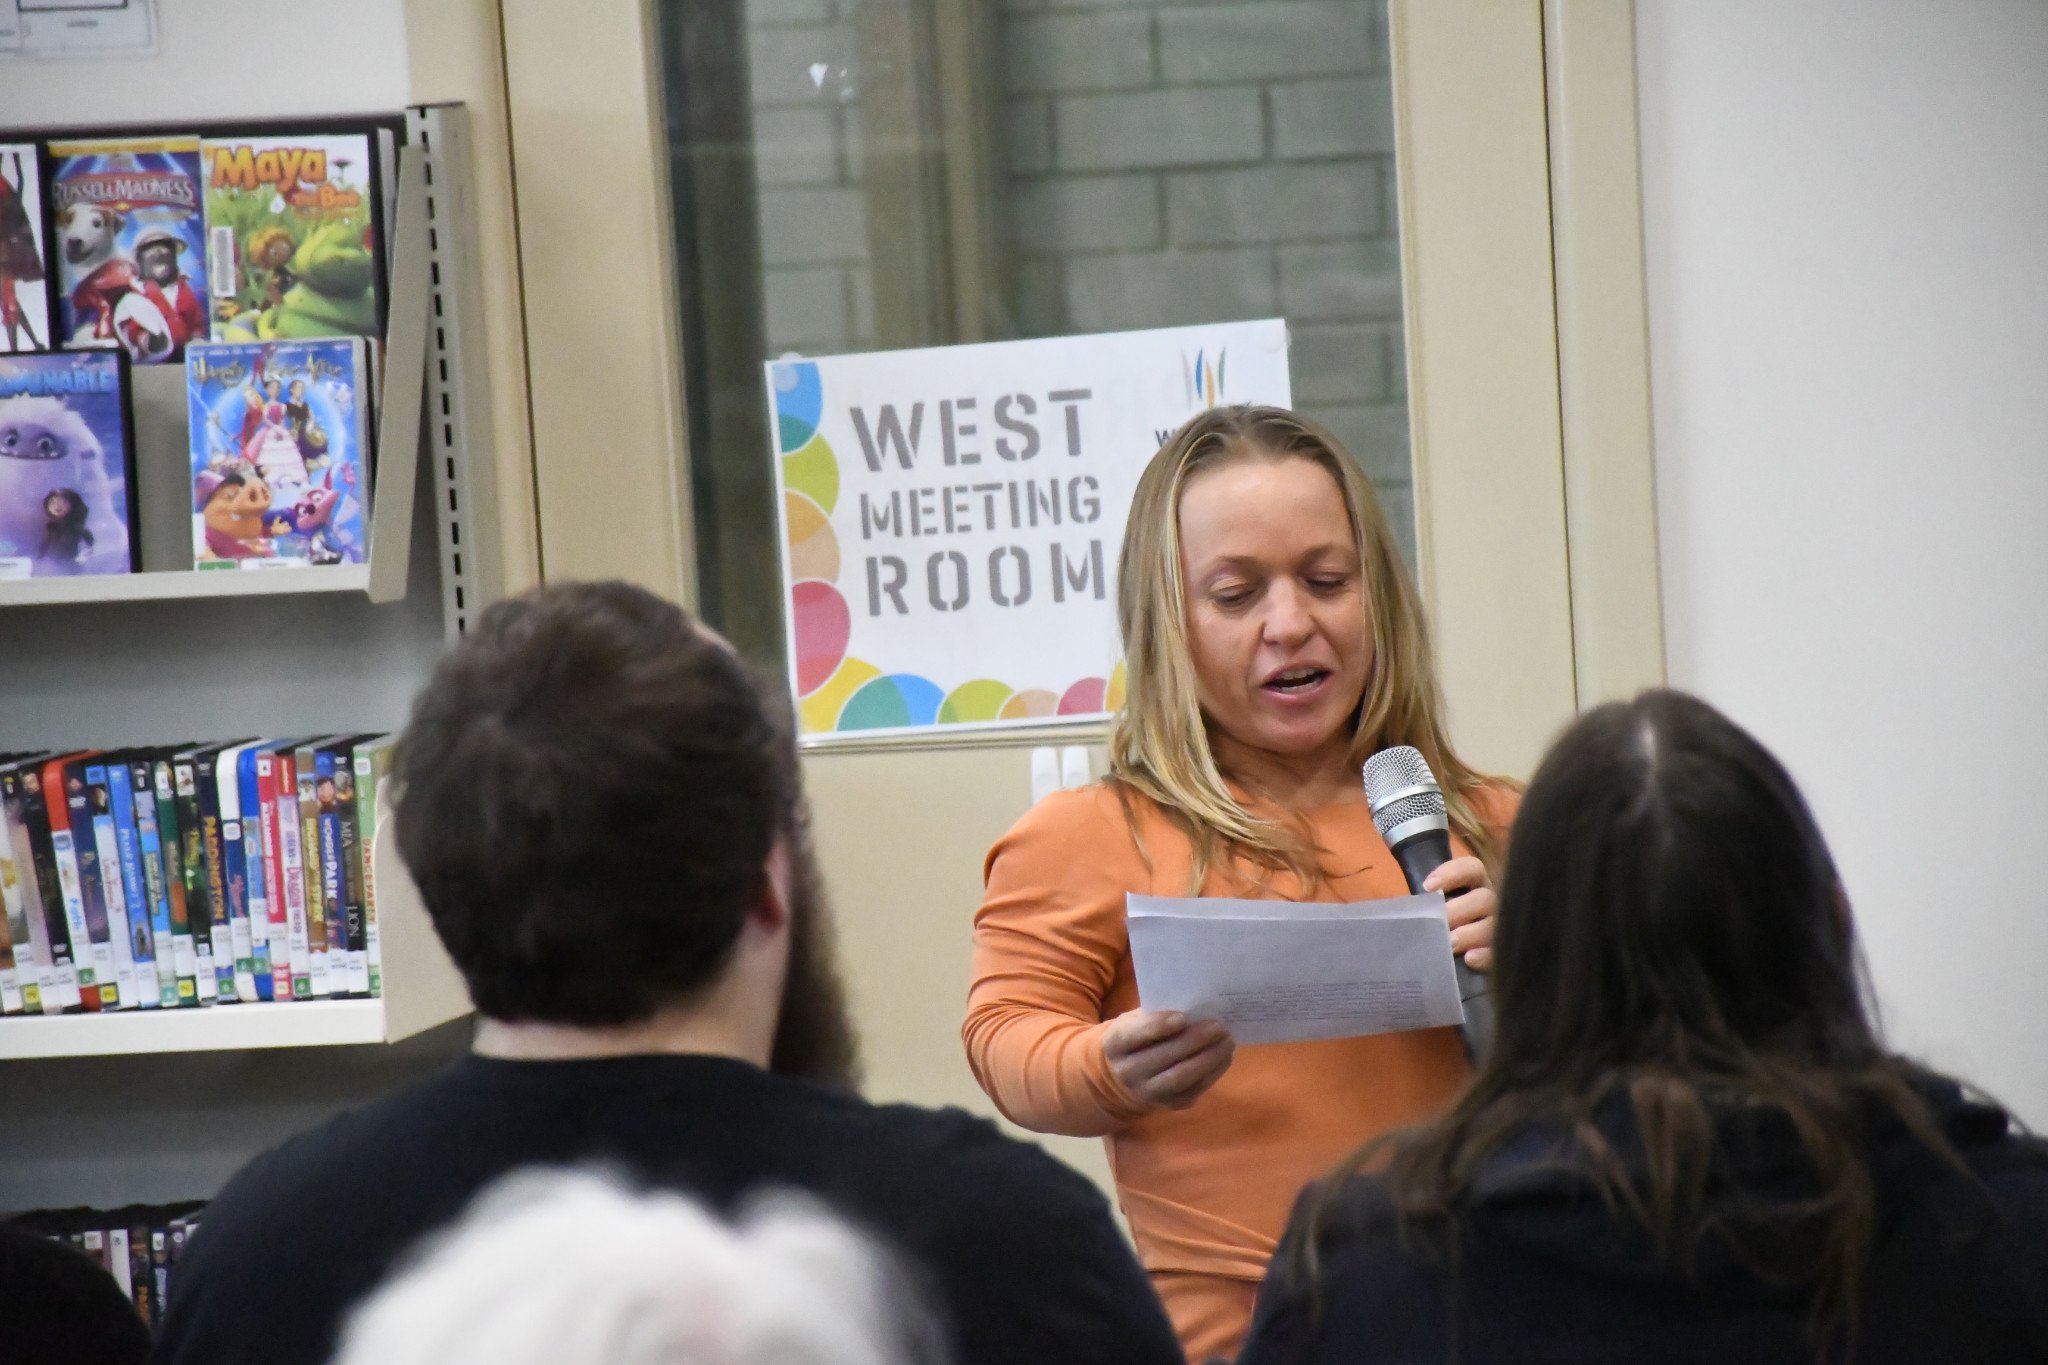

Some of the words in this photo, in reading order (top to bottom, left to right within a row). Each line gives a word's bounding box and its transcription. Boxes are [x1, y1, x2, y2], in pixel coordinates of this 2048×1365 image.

[211, 144, 328, 192] Maya
[848, 388, 1093, 474] WEST
[858, 474, 1101, 540] MEETING
[864, 539, 1106, 617] ROOM
[203, 815, 225, 920] PADDINGTON
[324, 861, 339, 900] PARK
